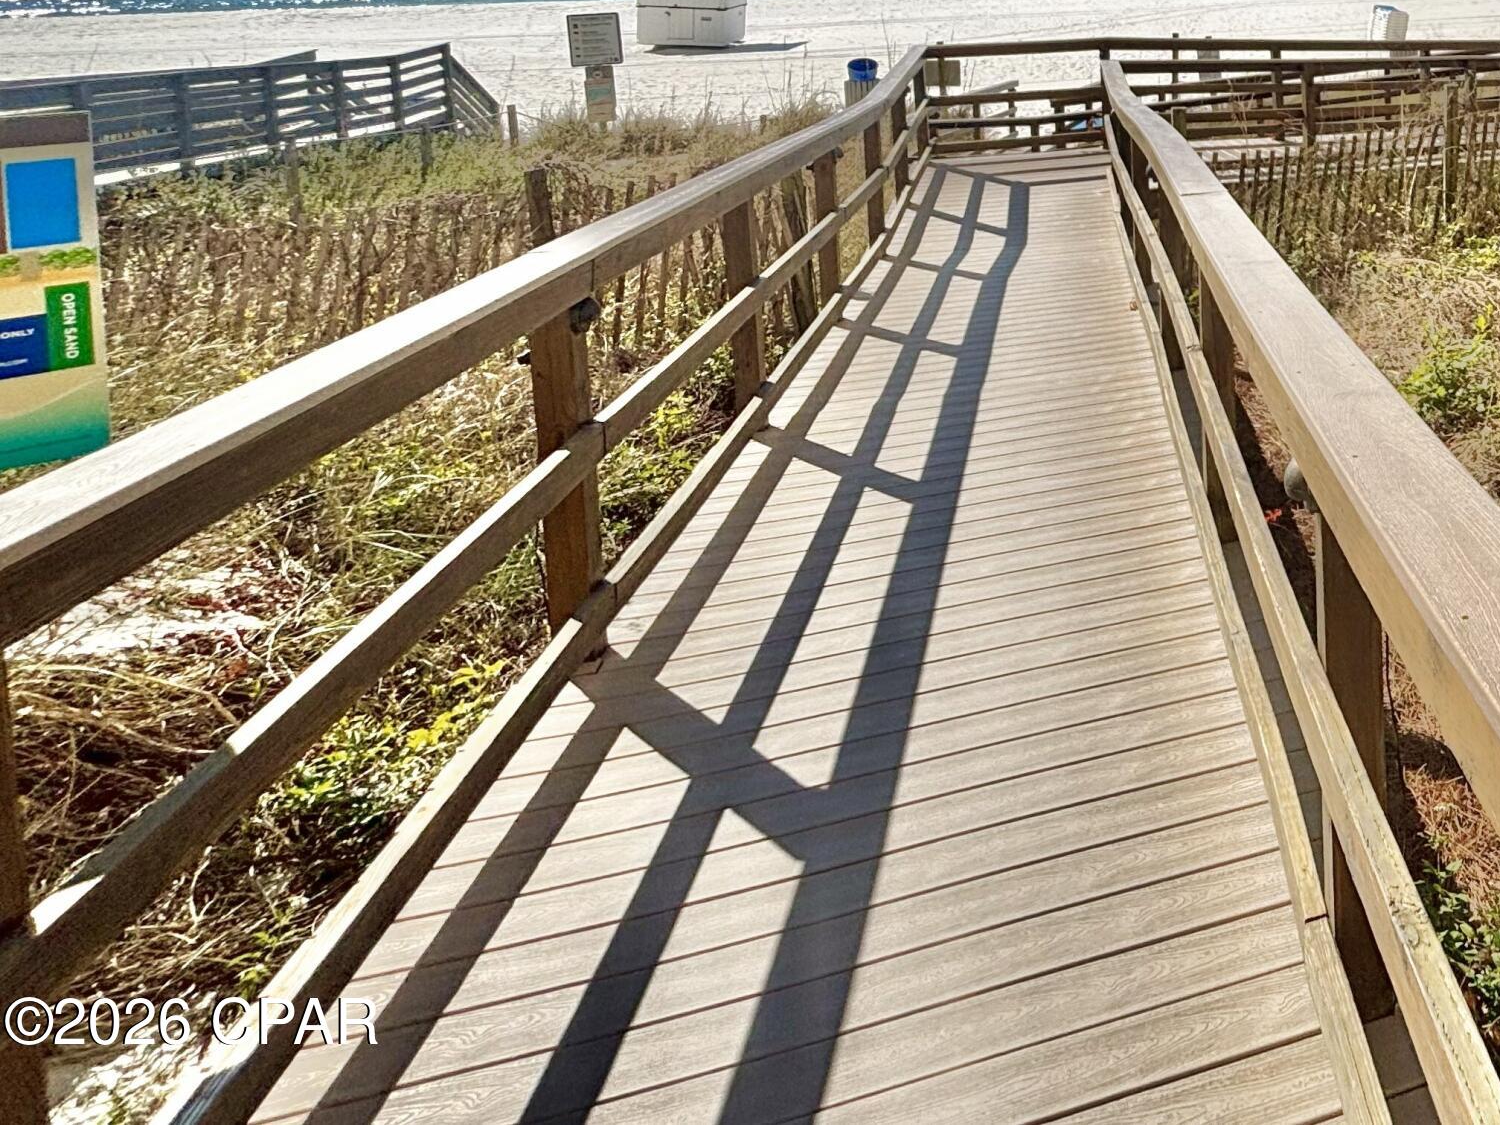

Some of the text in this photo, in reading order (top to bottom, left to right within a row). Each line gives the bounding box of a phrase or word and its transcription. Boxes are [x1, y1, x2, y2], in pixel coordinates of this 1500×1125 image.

[0, 327, 35, 340] ONLY
[61, 293, 80, 359] OPEN SAND
